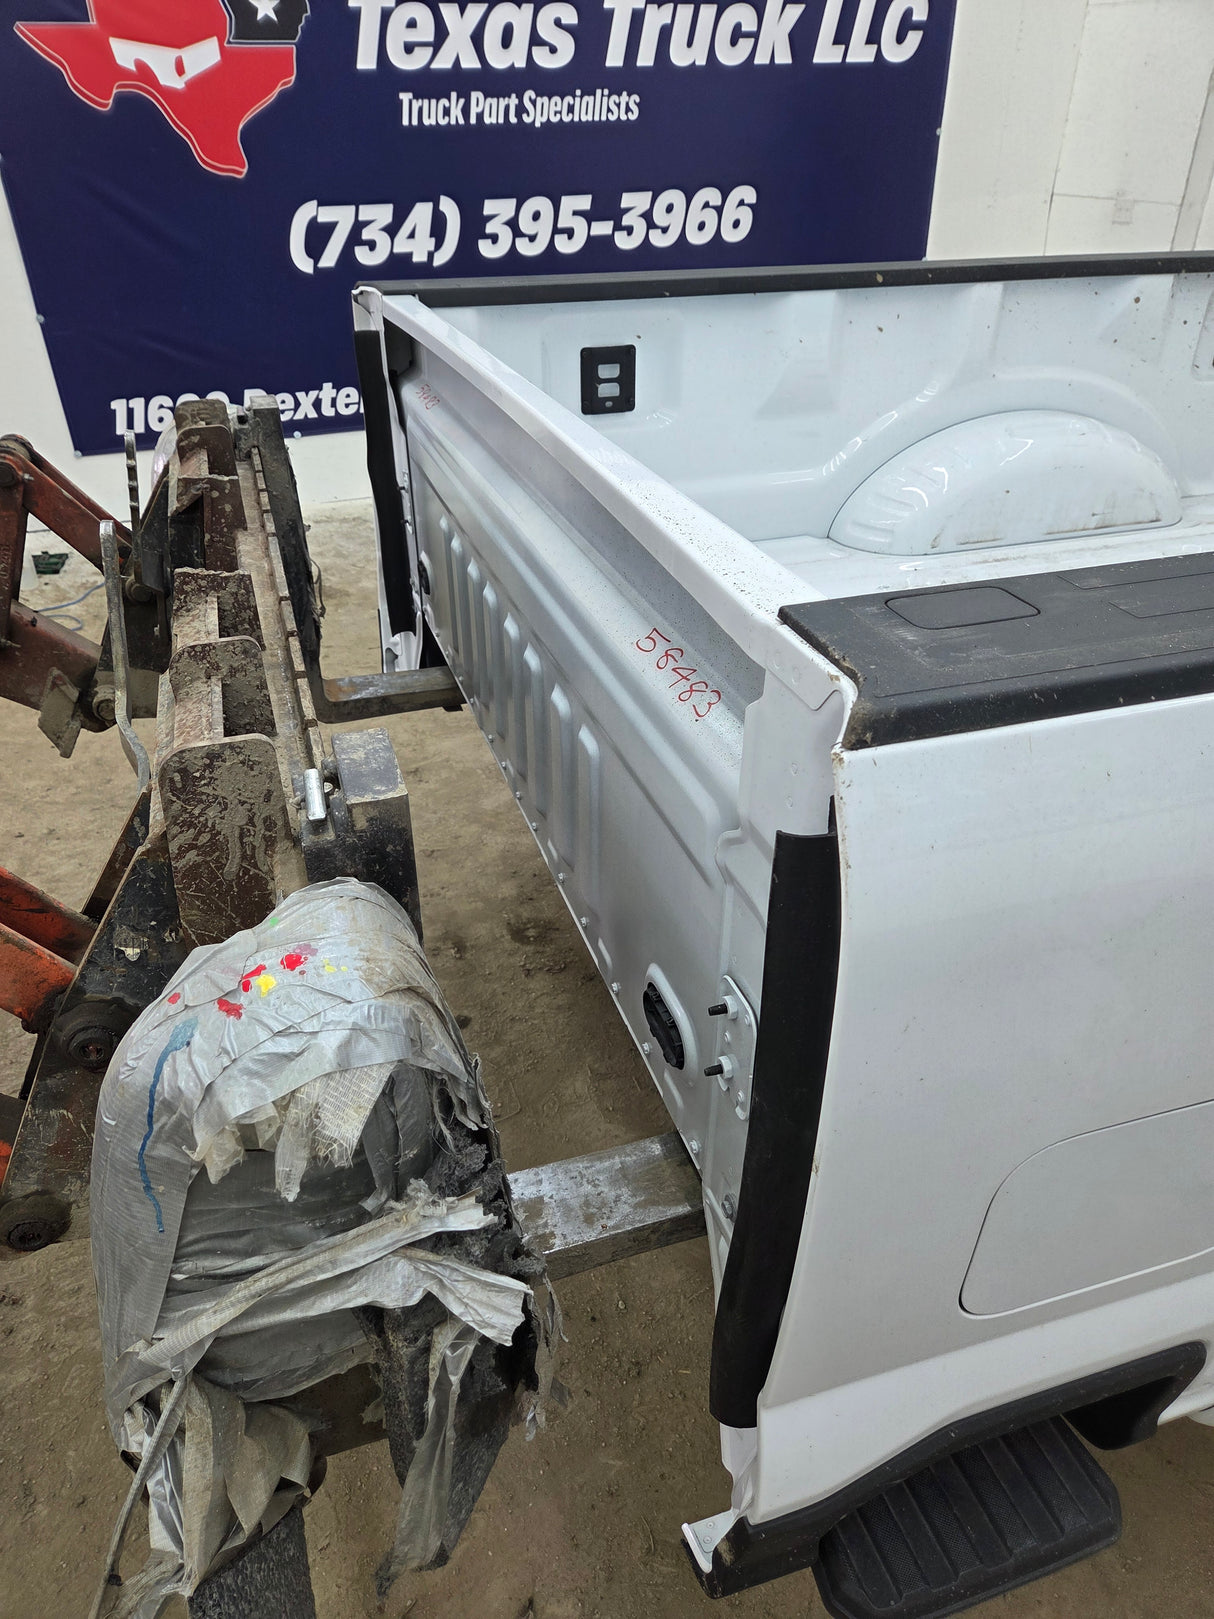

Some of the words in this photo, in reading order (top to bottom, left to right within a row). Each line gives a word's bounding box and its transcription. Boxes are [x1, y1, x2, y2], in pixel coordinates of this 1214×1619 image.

[348, 0, 578, 70] Texas
[603, 0, 806, 67] Truck
[812, 0, 929, 64] LLC
[399, 91, 465, 126] Truck
[470, 91, 519, 125] Part
[522, 89, 640, 128] Specialists
[289, 195, 461, 274] (734)
[478, 185, 757, 259] 395-3966
[110, 390, 230, 435] 116
[243, 382, 365, 421] exte
